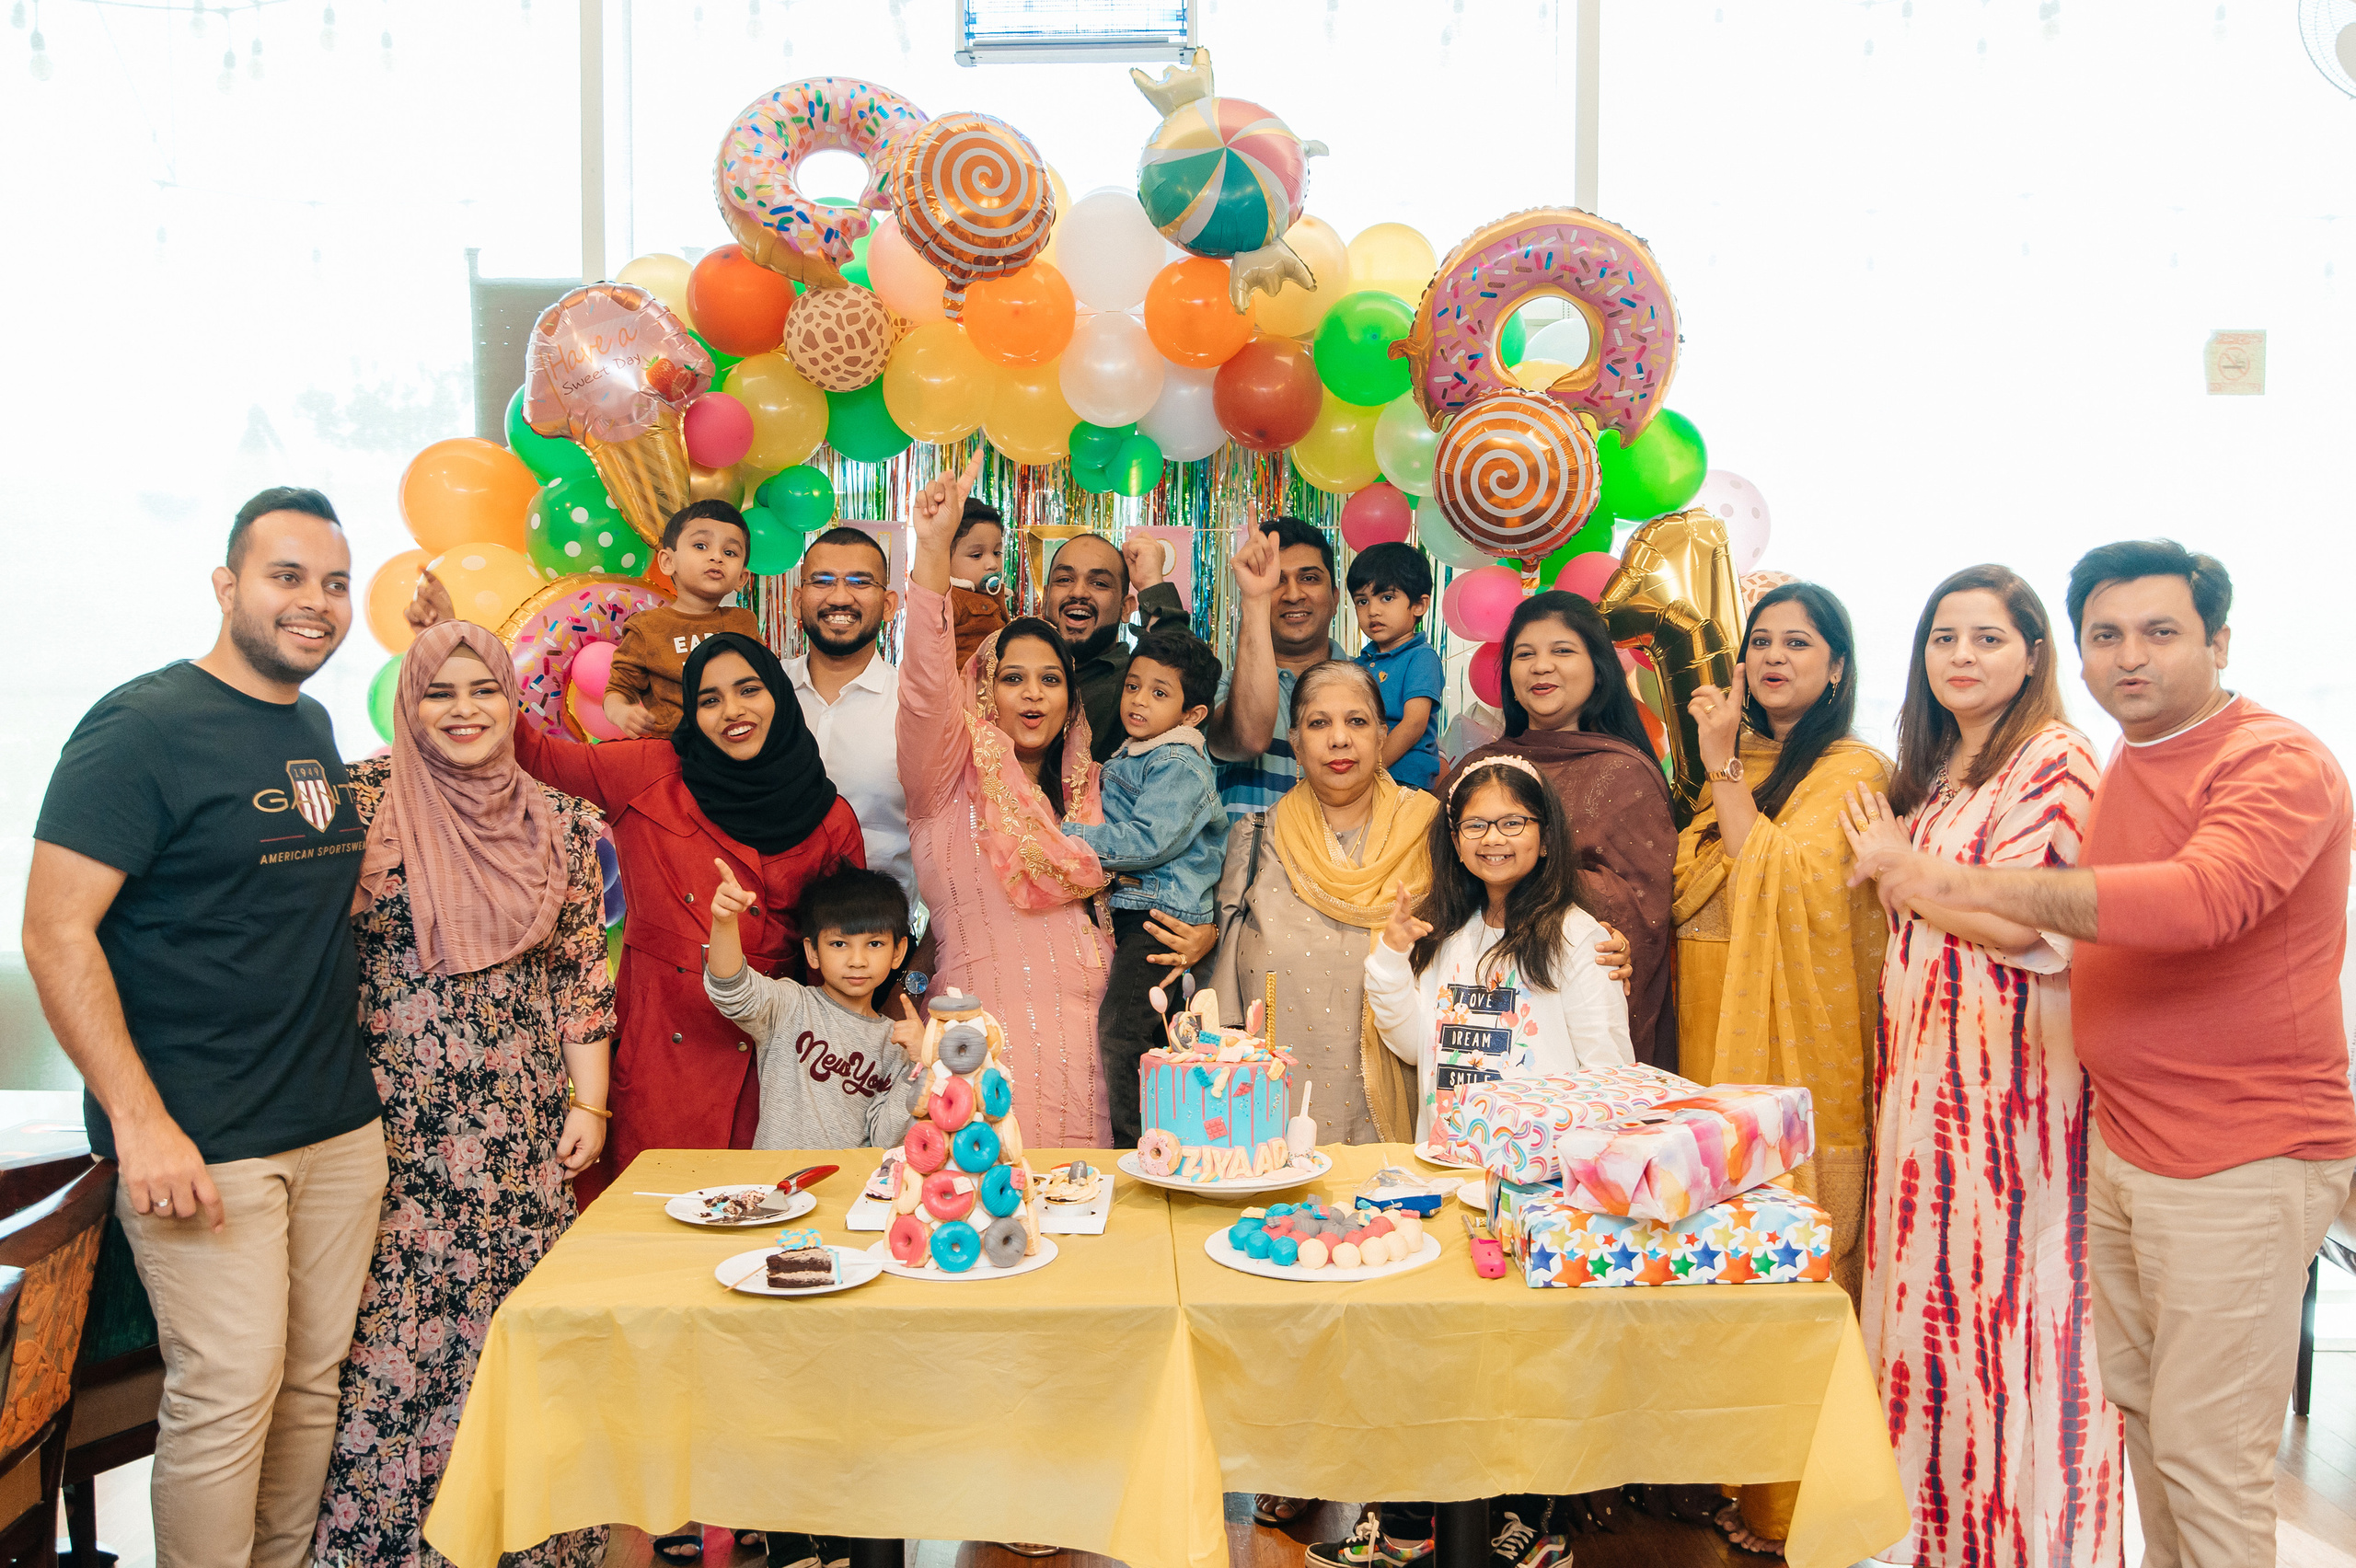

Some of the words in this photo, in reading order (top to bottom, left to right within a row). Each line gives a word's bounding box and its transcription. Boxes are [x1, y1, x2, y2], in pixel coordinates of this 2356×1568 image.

[546, 334, 612, 381] Have
[618, 327, 638, 348] a
[561, 365, 610, 396] Sweet
[612, 352, 641, 372] Day
[294, 767, 319, 778] 1949
[252, 784, 353, 813] GANT
[260, 848, 315, 866] AMERICAN
[317, 840, 366, 857] SPORTSWEA
[1459, 991, 1493, 1009] LOVE
[1451, 1030, 1492, 1049] DREAM
[795, 1030, 852, 1083] New
[841, 1051, 893, 1099] York
[1181, 1137, 1288, 1179] ZIYAAD
